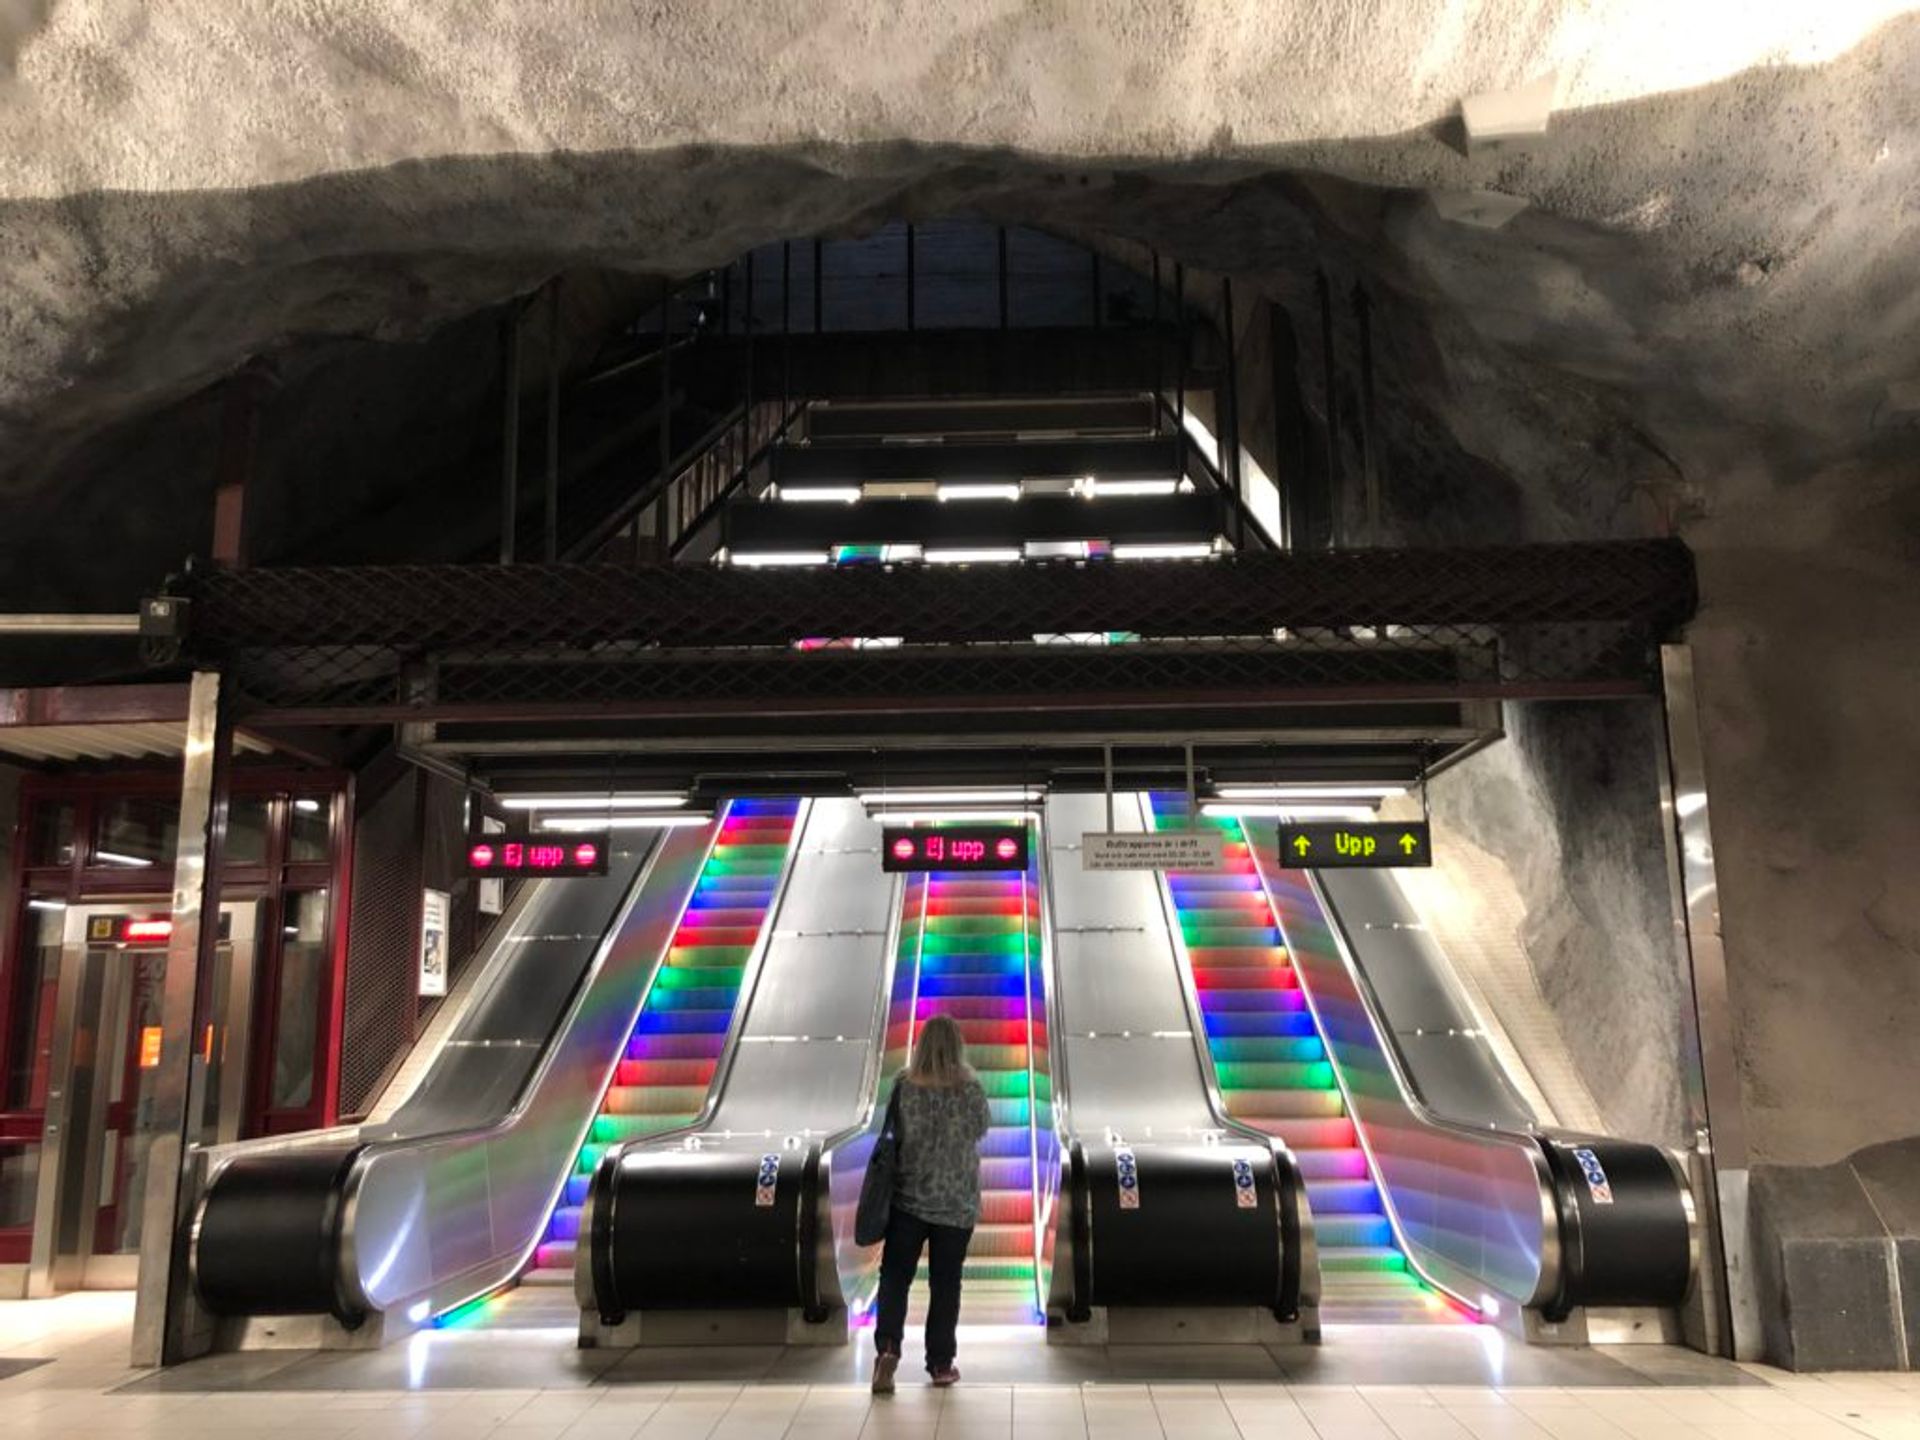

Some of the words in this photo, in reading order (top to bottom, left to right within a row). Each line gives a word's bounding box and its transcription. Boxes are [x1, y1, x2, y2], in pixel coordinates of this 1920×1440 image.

[505, 844, 523, 866] Ej
[529, 846, 564, 866] upp
[926, 837, 944, 861] Ej
[952, 841, 984, 861] upp
[1335, 832, 1376, 856] Upp
